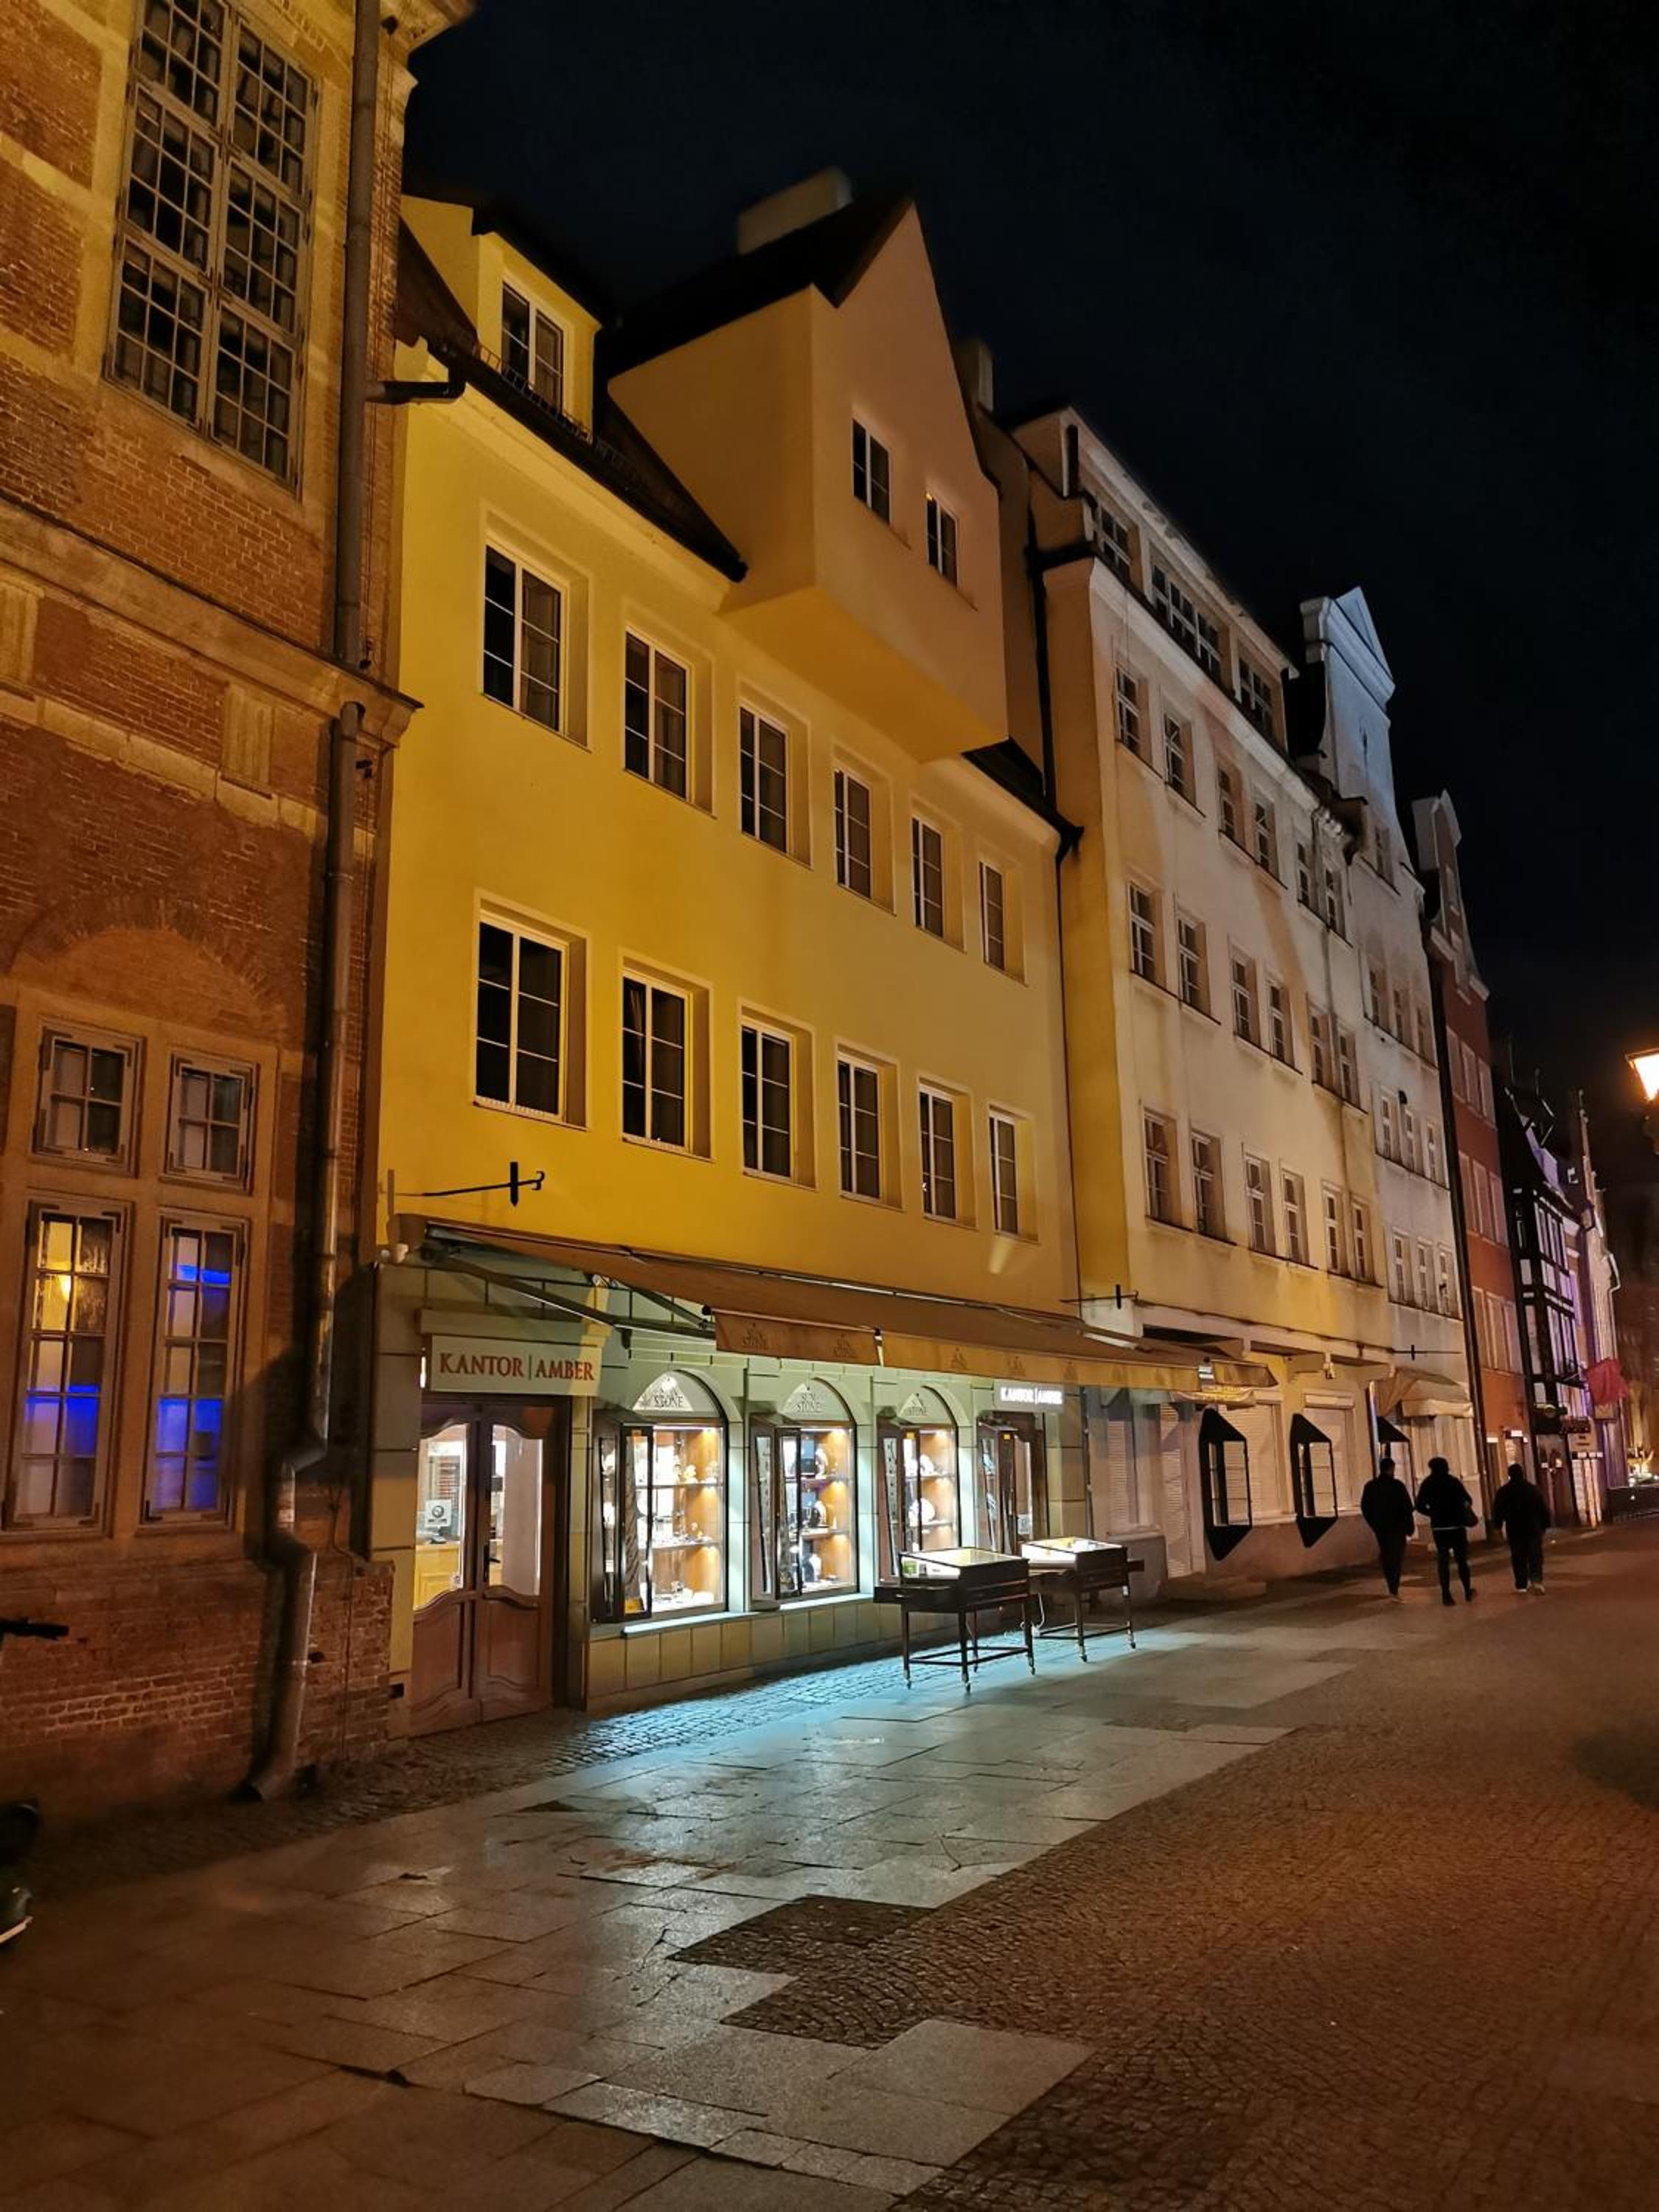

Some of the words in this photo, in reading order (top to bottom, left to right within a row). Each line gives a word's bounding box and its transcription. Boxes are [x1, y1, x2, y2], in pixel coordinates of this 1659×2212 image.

[439, 1352, 524, 1377] KANTOR
[535, 1359, 595, 1380] AMBER
[654, 1395, 684, 1407] STONE
